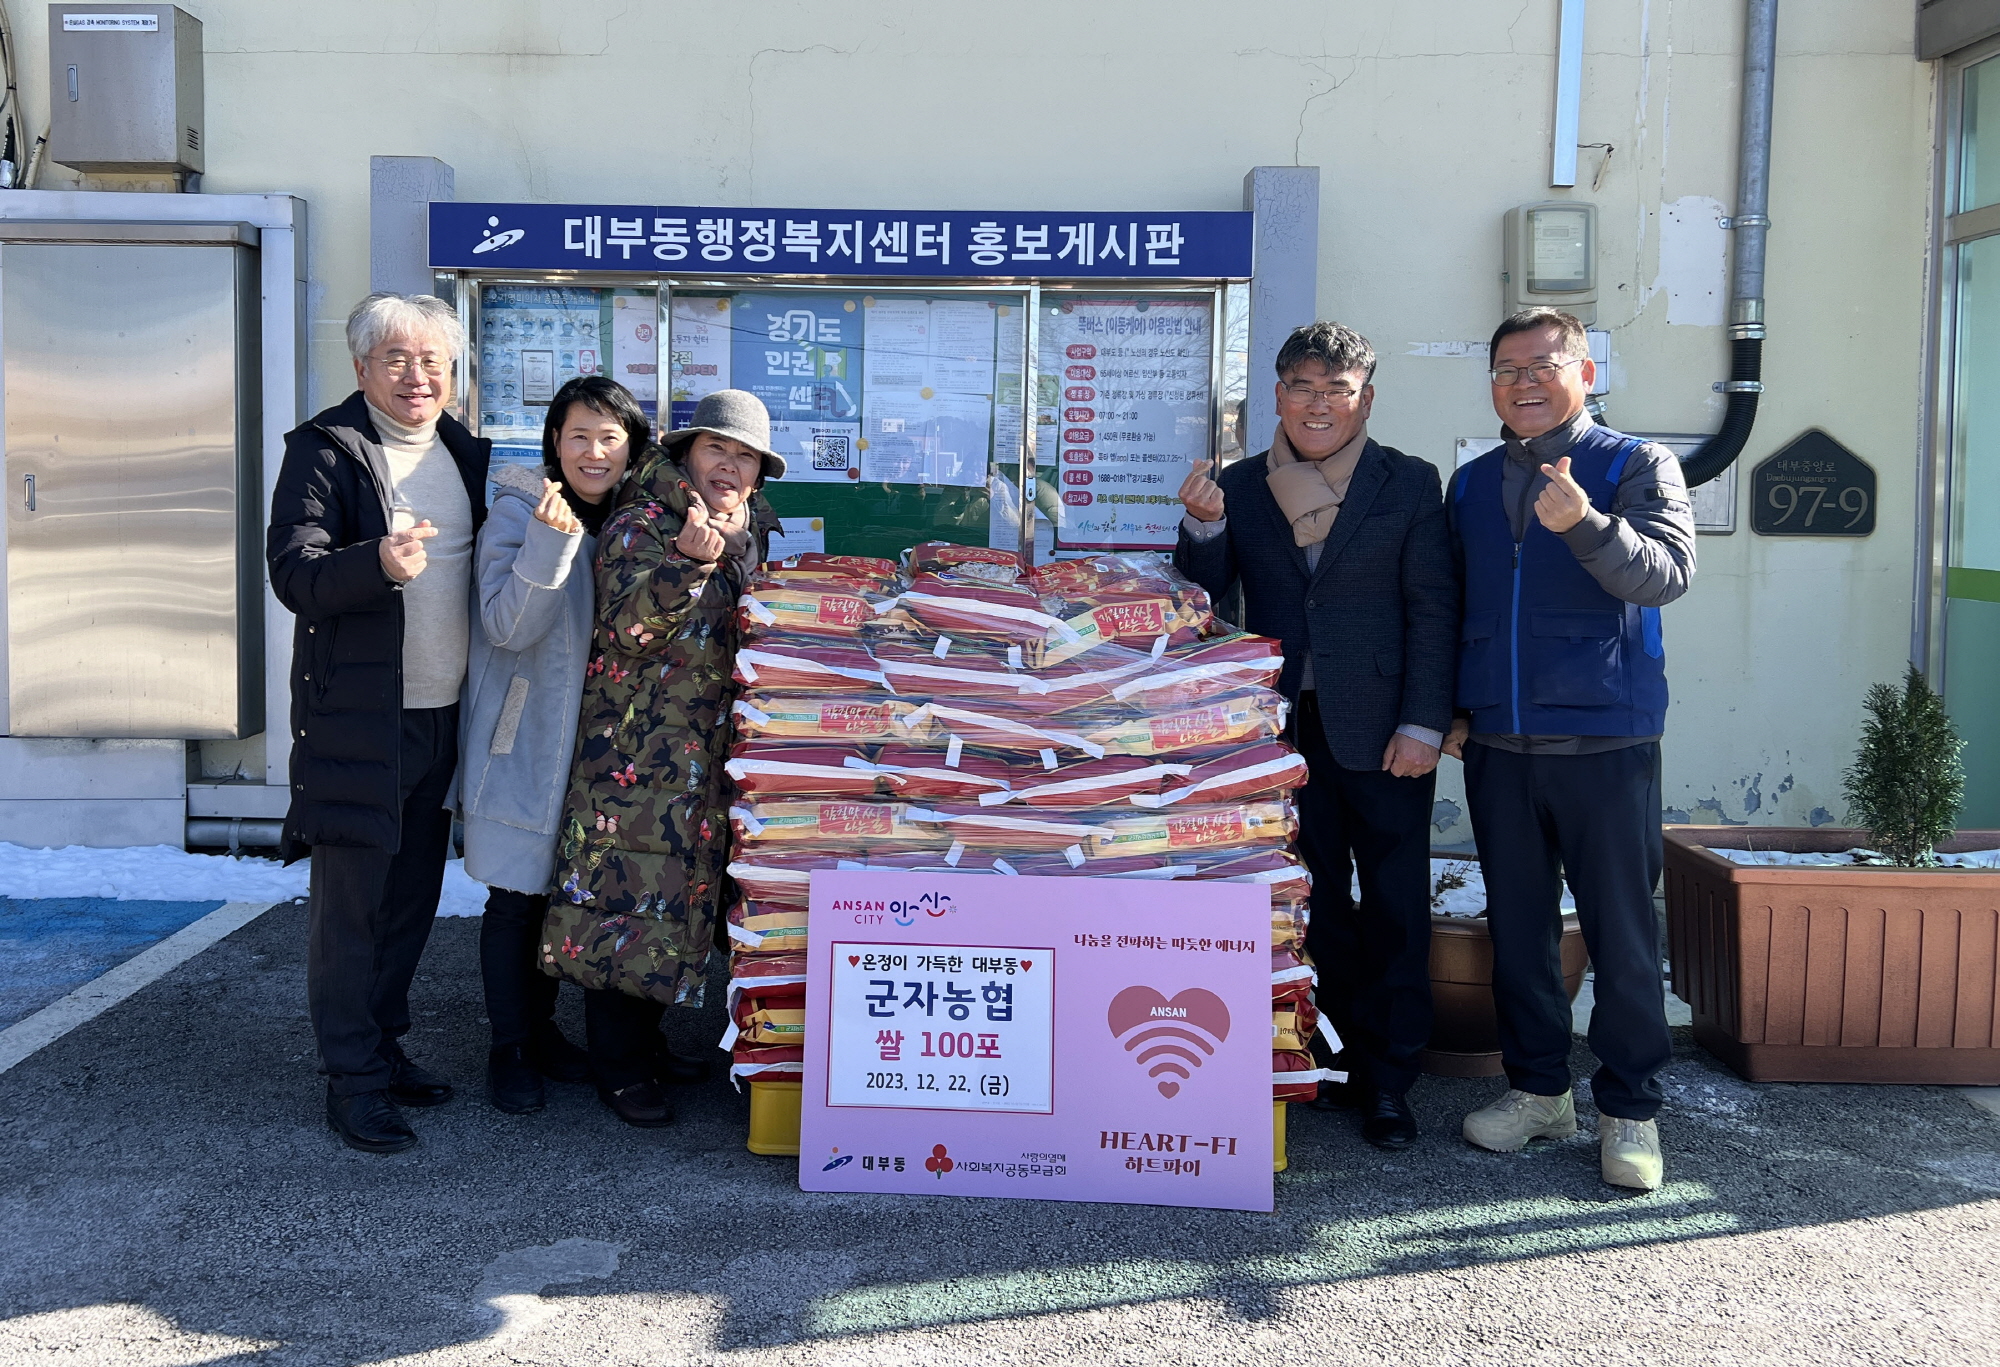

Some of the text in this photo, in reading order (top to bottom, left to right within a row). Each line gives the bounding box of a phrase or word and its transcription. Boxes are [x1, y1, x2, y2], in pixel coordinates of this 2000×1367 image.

[564, 215, 1185, 267] 대부동행정복지센터 홍보게시판
[766, 309, 841, 342] 경기도
[1078, 315, 1202, 336] 똑버스 (이동케어) 이용방법 안내
[694, 335, 709, 344] 쉼터
[683, 364, 717, 376] OPEN
[765, 351, 815, 376] 인권
[1099, 411, 1115, 420] 07:00
[1122, 411, 1138, 420] 21:00
[1099, 432, 1119, 442] 1,450원
[1130, 452, 1141, 462] 또는
[1777, 459, 1836, 472] 대부중앙로
[1768, 484, 1869, 529] 97-9
[1119, 618, 1142, 632] 나는
[1133, 603, 1159, 630] 쌀
[845, 720, 870, 733] 나는
[1179, 728, 1205, 744] 나는
[824, 805, 888, 835] 감칠맛 나는 쌀
[1172, 811, 1239, 844] 감칠맛 나는 쌀
[832, 900, 885, 911] ANSAN
[854, 914, 884, 925] CITY
[1074, 934, 1112, 948] 나눔을
[1116, 935, 1168, 950] 전파하는
[1215, 939, 1255, 954] 에너지
[862, 954, 1018, 975] 온정이 가득한 대부동
[865, 980, 1013, 1022] 군자농협
[1150, 1006, 1187, 1018] ANSAN
[875, 1029, 1002, 1061] 쌀 100포
[866, 1072, 1010, 1097] 2023. 12. 22. (금)
[1100, 1131, 1237, 1156] HEART-FI
[862, 1155, 906, 1173] 대부동
[1021, 1152, 1066, 1163] 사랑의열매
[1125, 1156, 1201, 1177] 하트파이
[955, 1161, 1067, 1178] 사회복지공동모금회
